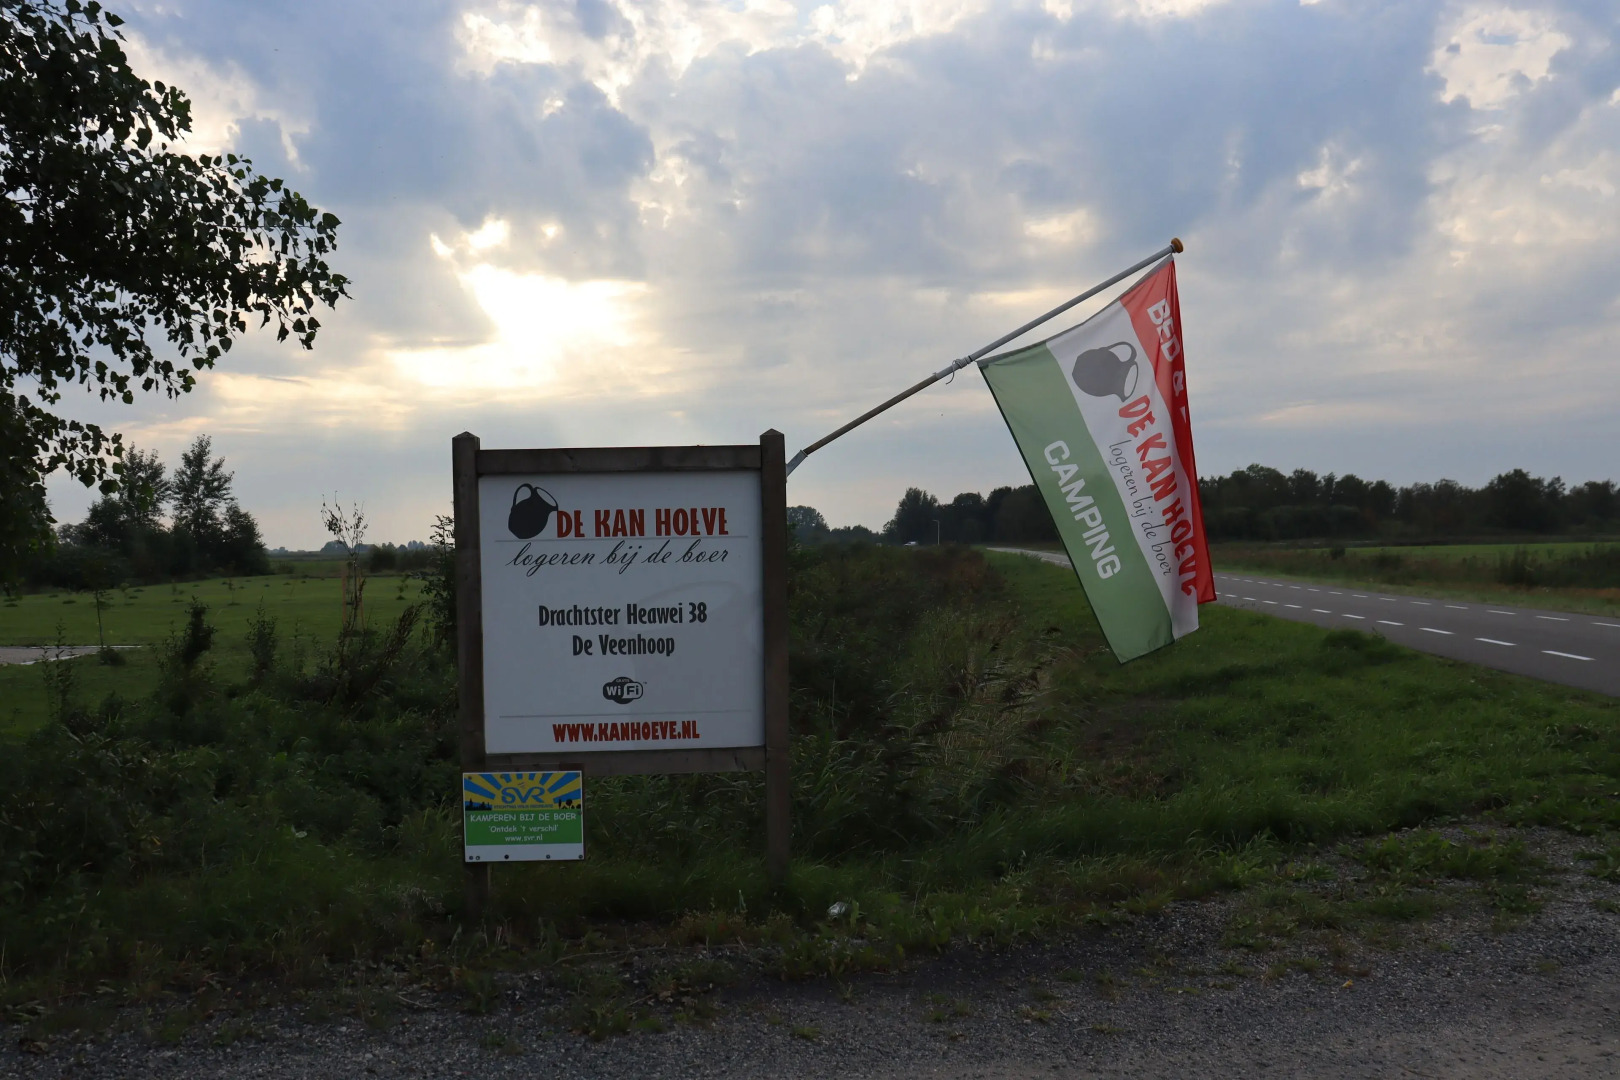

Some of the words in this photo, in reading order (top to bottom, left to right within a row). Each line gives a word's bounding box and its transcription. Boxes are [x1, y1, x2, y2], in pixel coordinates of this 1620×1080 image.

[1118, 394, 1156, 438] DE
[1108, 439, 1137, 497] logeren
[1135, 432, 1178, 502] KAN
[1044, 440, 1121, 580] CAMPING
[1130, 495, 1153, 518] bij
[556, 509, 585, 538] DE
[594, 508, 645, 538] KAN
[655, 507, 729, 536] HOEVE
[1141, 523, 1165, 540] de
[505, 542, 595, 578] logeren
[599, 540, 643, 575] bij
[641, 539, 672, 564] de
[675, 538, 729, 564] boer
[1152, 540, 1172, 576] boer
[538, 604, 621, 627] Drachtster
[626, 602, 683, 625] Heawei
[688, 601, 708, 623] 38
[572, 635, 593, 656] De
[598, 633, 675, 657] Veenhoop
[552, 720, 701, 743] WWW.KANHOEVE.NL
[501, 786, 546, 804] SVR
[470, 813, 517, 822] KAMPEREN
[520, 813, 535, 821] BIJ
[539, 812, 550, 821] DE
[553, 812, 577, 820] BOER
[504, 834, 543, 842] www.svr.nl
